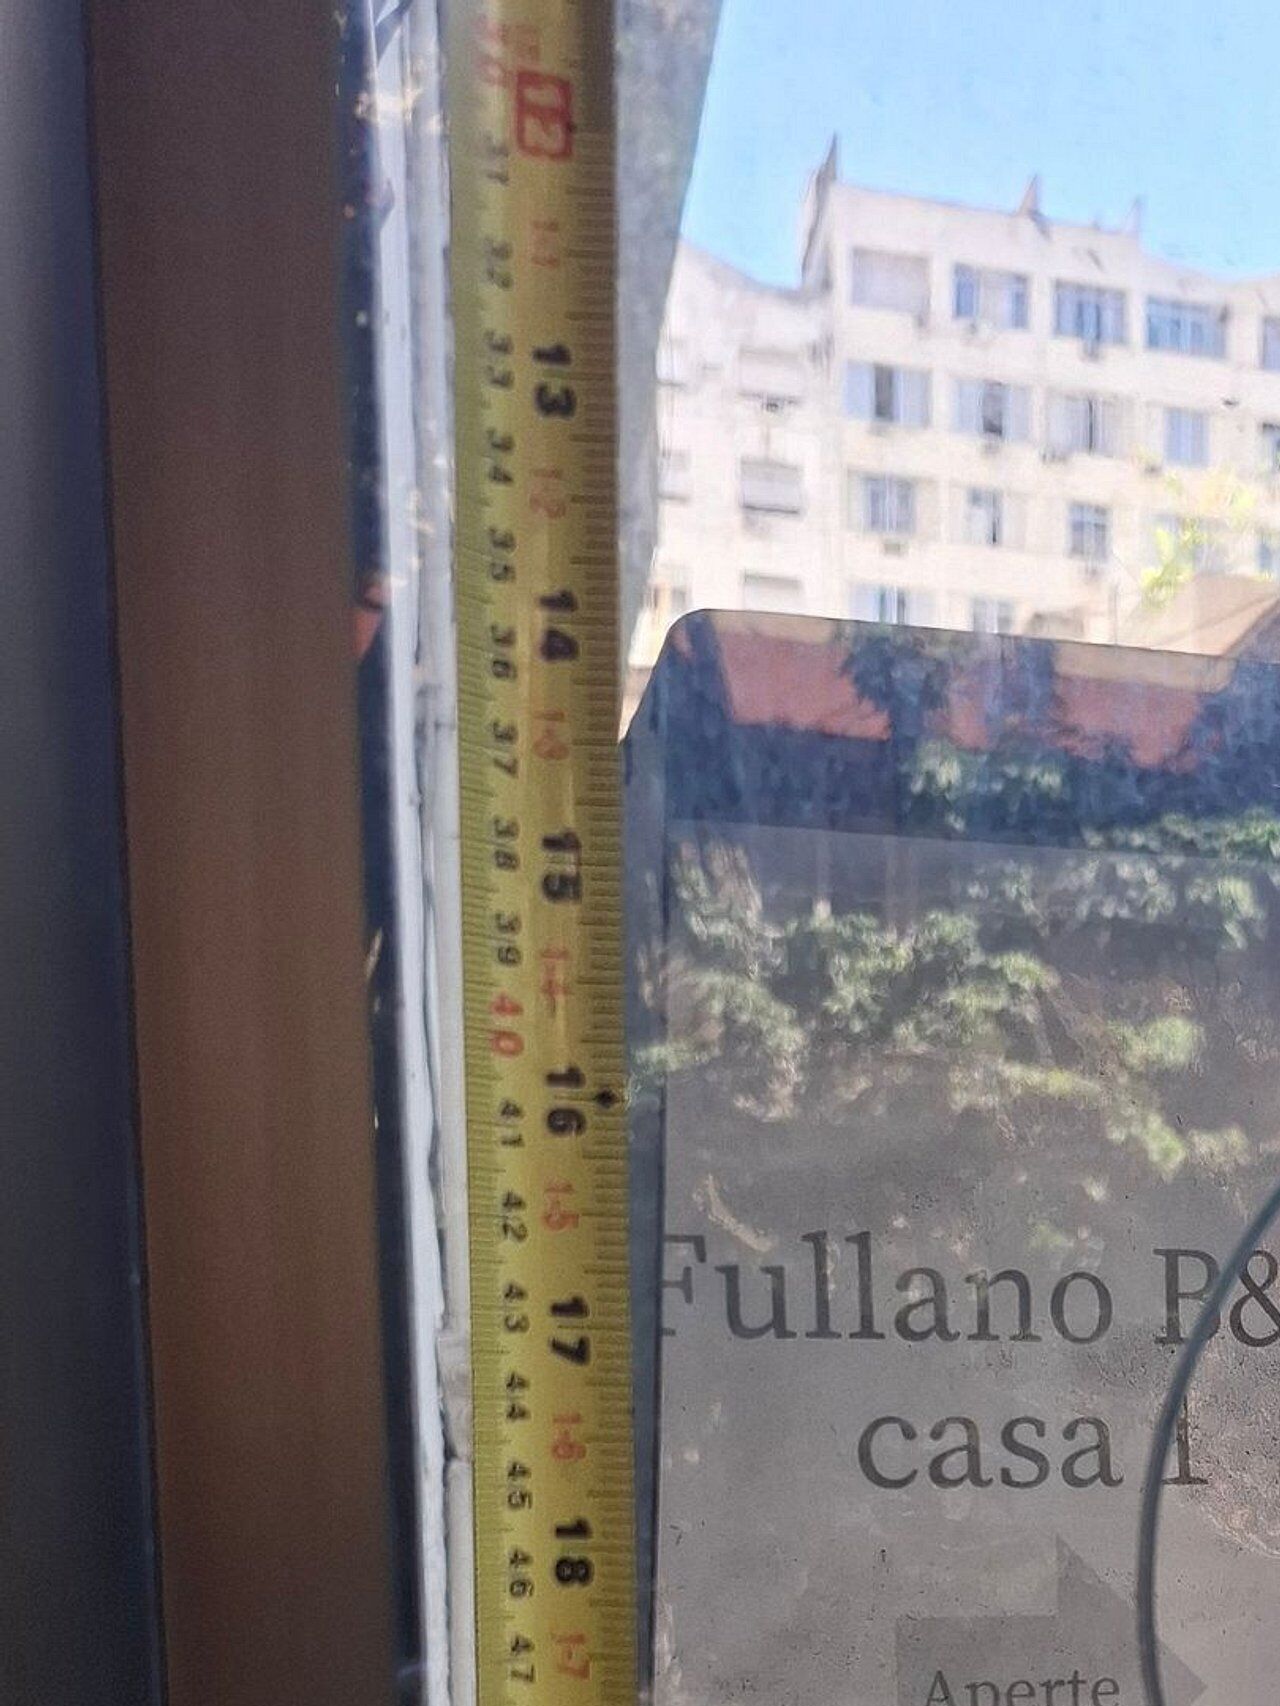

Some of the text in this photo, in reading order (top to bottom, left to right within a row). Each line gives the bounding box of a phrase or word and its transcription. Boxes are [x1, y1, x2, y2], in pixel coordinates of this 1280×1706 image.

[485, 238, 514, 291] 32
[485, 331, 515, 391] 33
[532, 344, 577, 420] 13
[486, 430, 515, 486] 34
[489, 528, 517, 584] 35
[490, 625, 517, 681] 36
[538, 590, 580, 663] 14
[492, 720, 519, 777] 37
[493, 818, 520, 873] 38
[541, 831, 584, 905] 15
[496, 912, 522, 967] 39
[490, 994, 525, 1058] 40
[500, 1100, 525, 1149] 41
[545, 1066, 588, 1138] 16
[502, 1192, 528, 1244] 42
[503, 1283, 529, 1334] 43
[550, 1295, 590, 1366] 17
[506, 1372, 532, 1421] 44
[856, 1412, 1124, 1490] casa
[507, 1462, 533, 1510] 45
[508, 1549, 534, 1599] 46
[554, 1518, 594, 1588] 18
[510, 1636, 536, 1684] 47
